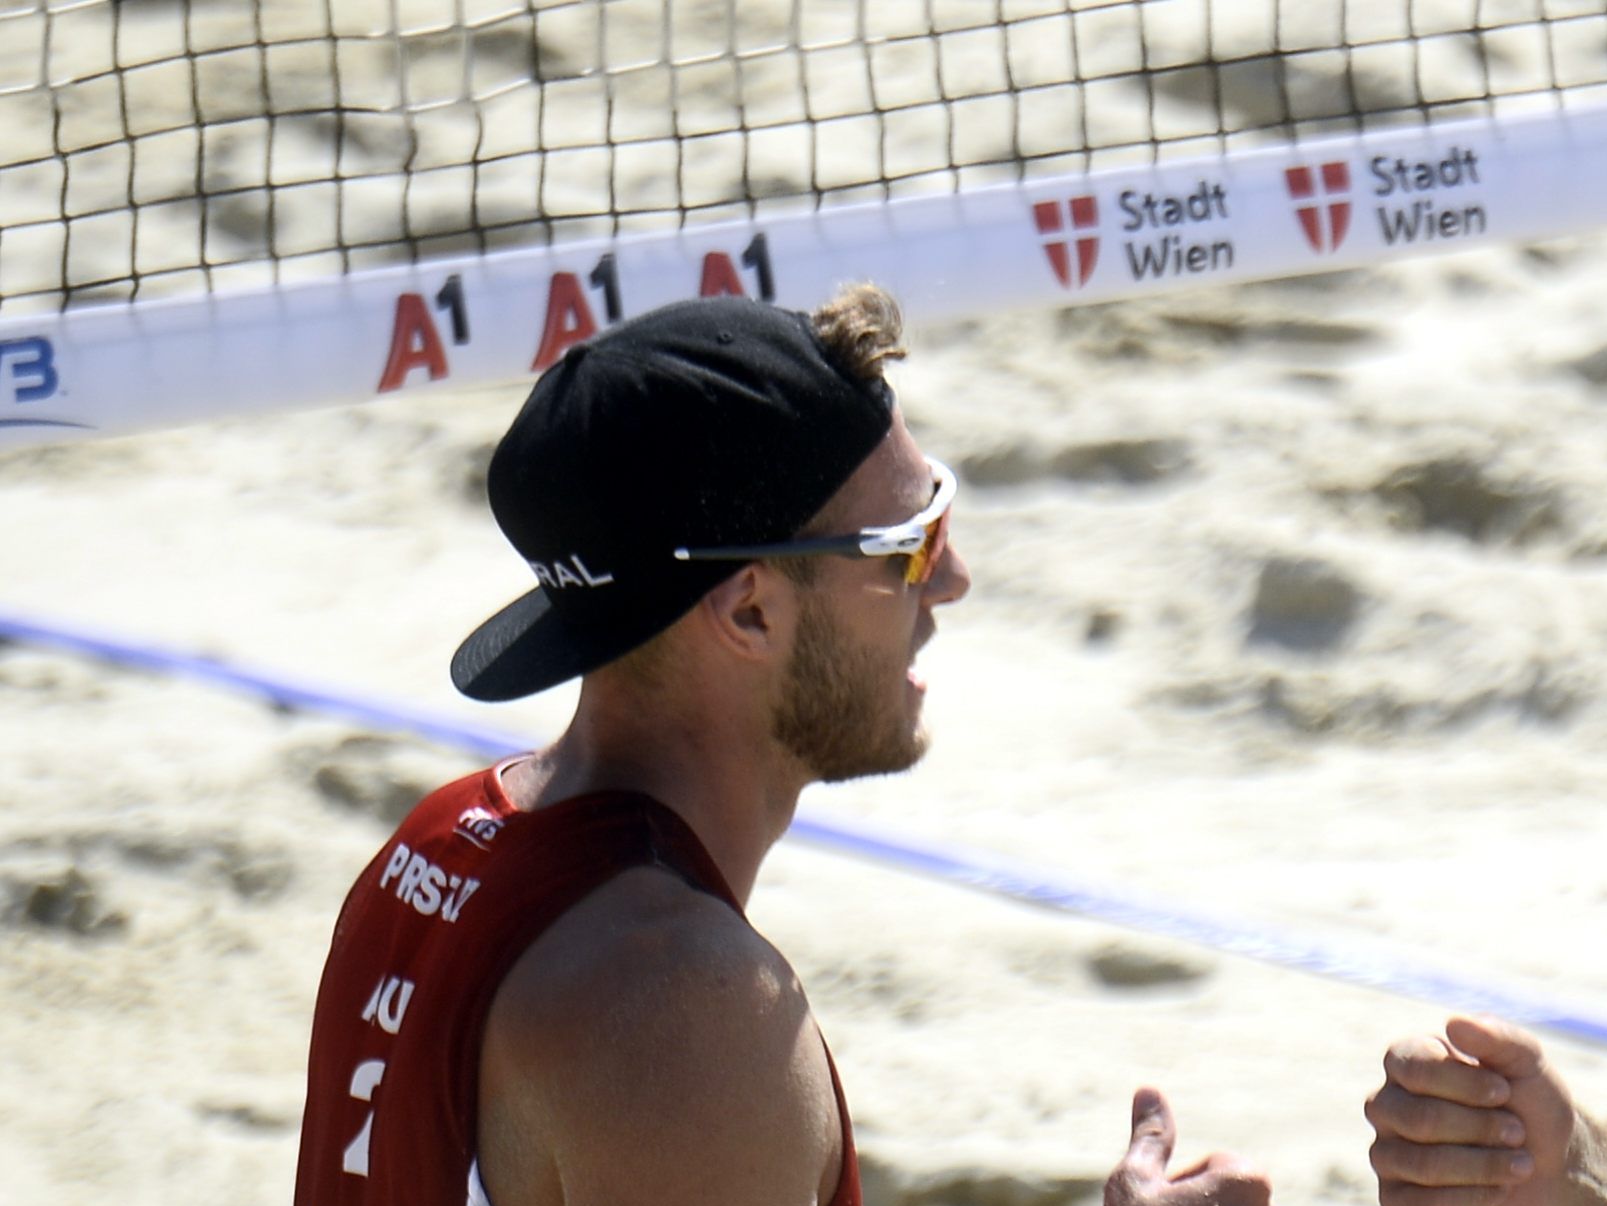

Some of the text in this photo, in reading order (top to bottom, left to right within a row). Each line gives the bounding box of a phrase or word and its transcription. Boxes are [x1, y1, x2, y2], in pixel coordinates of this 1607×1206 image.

[1370, 147, 1481, 197] Stadt
[1119, 181, 1228, 231] Stadt
[1378, 201, 1486, 246] Wien
[1126, 238, 1233, 281] Wien
[378, 274, 470, 394] A1
[531, 253, 623, 372] A1
